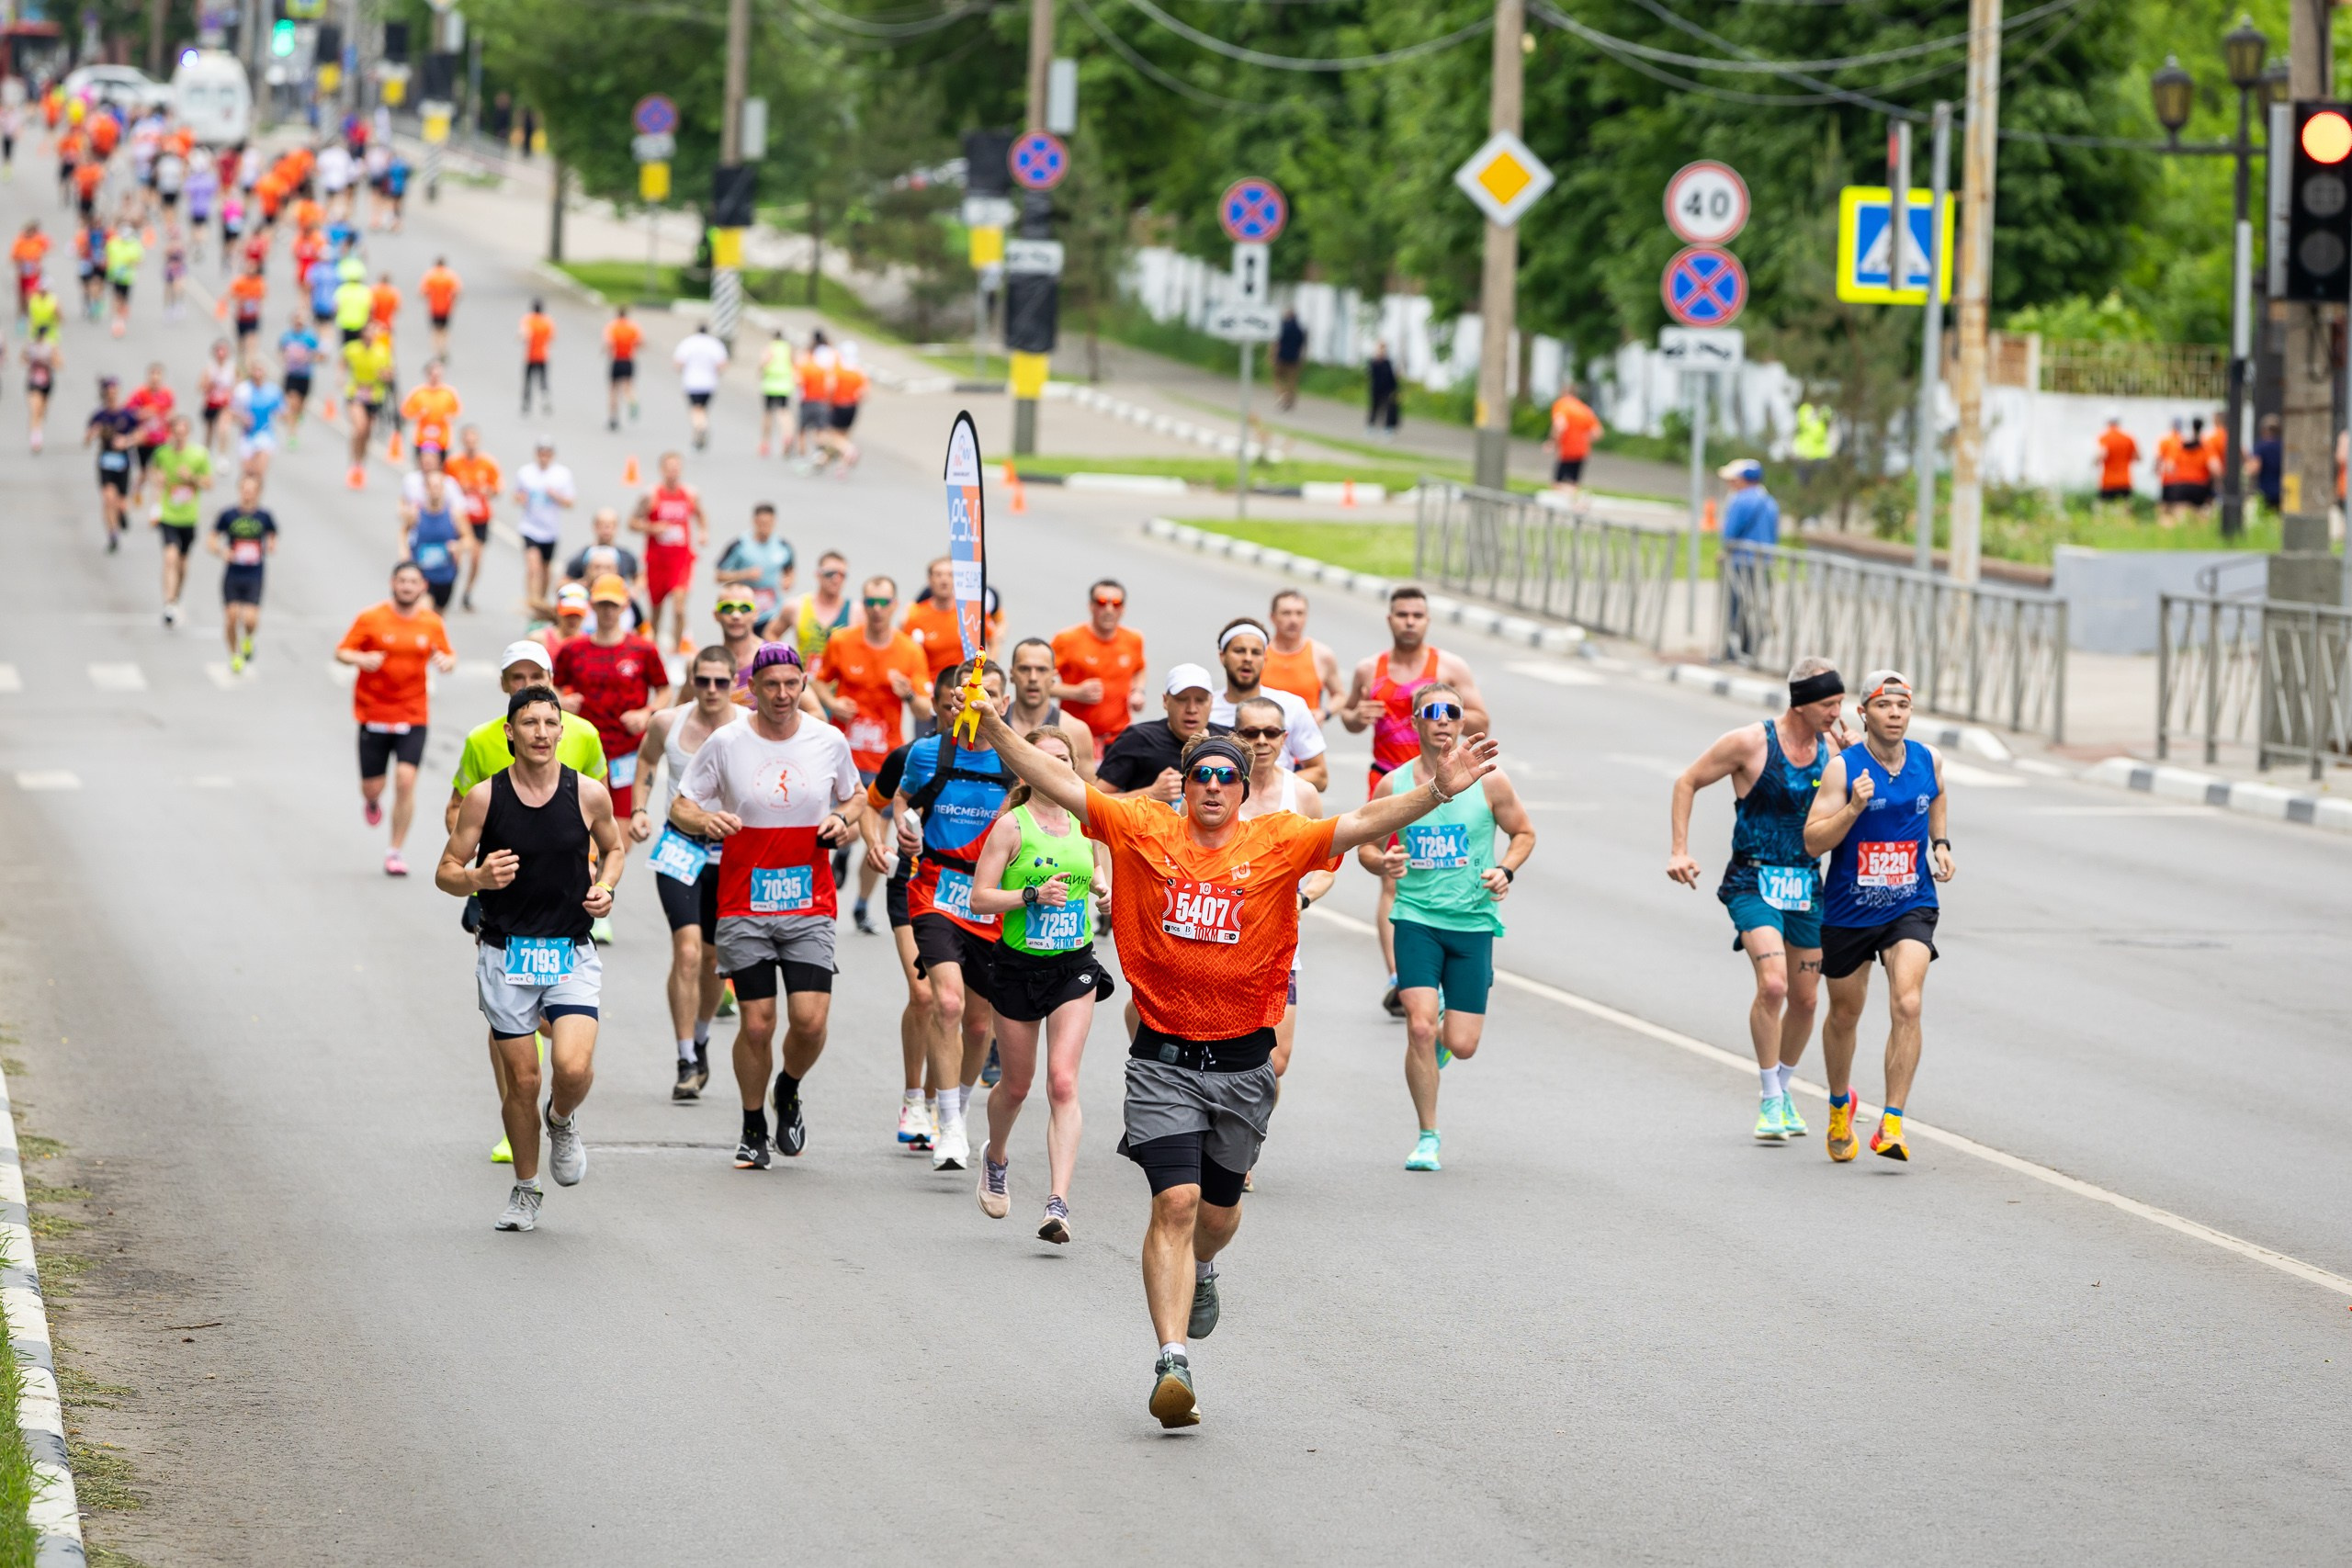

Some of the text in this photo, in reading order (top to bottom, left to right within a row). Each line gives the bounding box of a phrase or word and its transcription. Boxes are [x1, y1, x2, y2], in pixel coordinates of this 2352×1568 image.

[1683, 188, 1730, 220] 40
[934, 804, 999, 819] ПЕЙСМЕЙКЕ
[657, 840, 695, 872] 7022
[1417, 835, 1457, 858] 7264
[1869, 852, 1909, 874] 5229
[762, 876, 801, 901] 7035
[948, 881, 974, 908] 72
[1770, 875, 1803, 899] 7140
[1175, 892, 1230, 928] 5407
[1039, 912, 1078, 937] 7253
[520, 948, 560, 974] 7193
